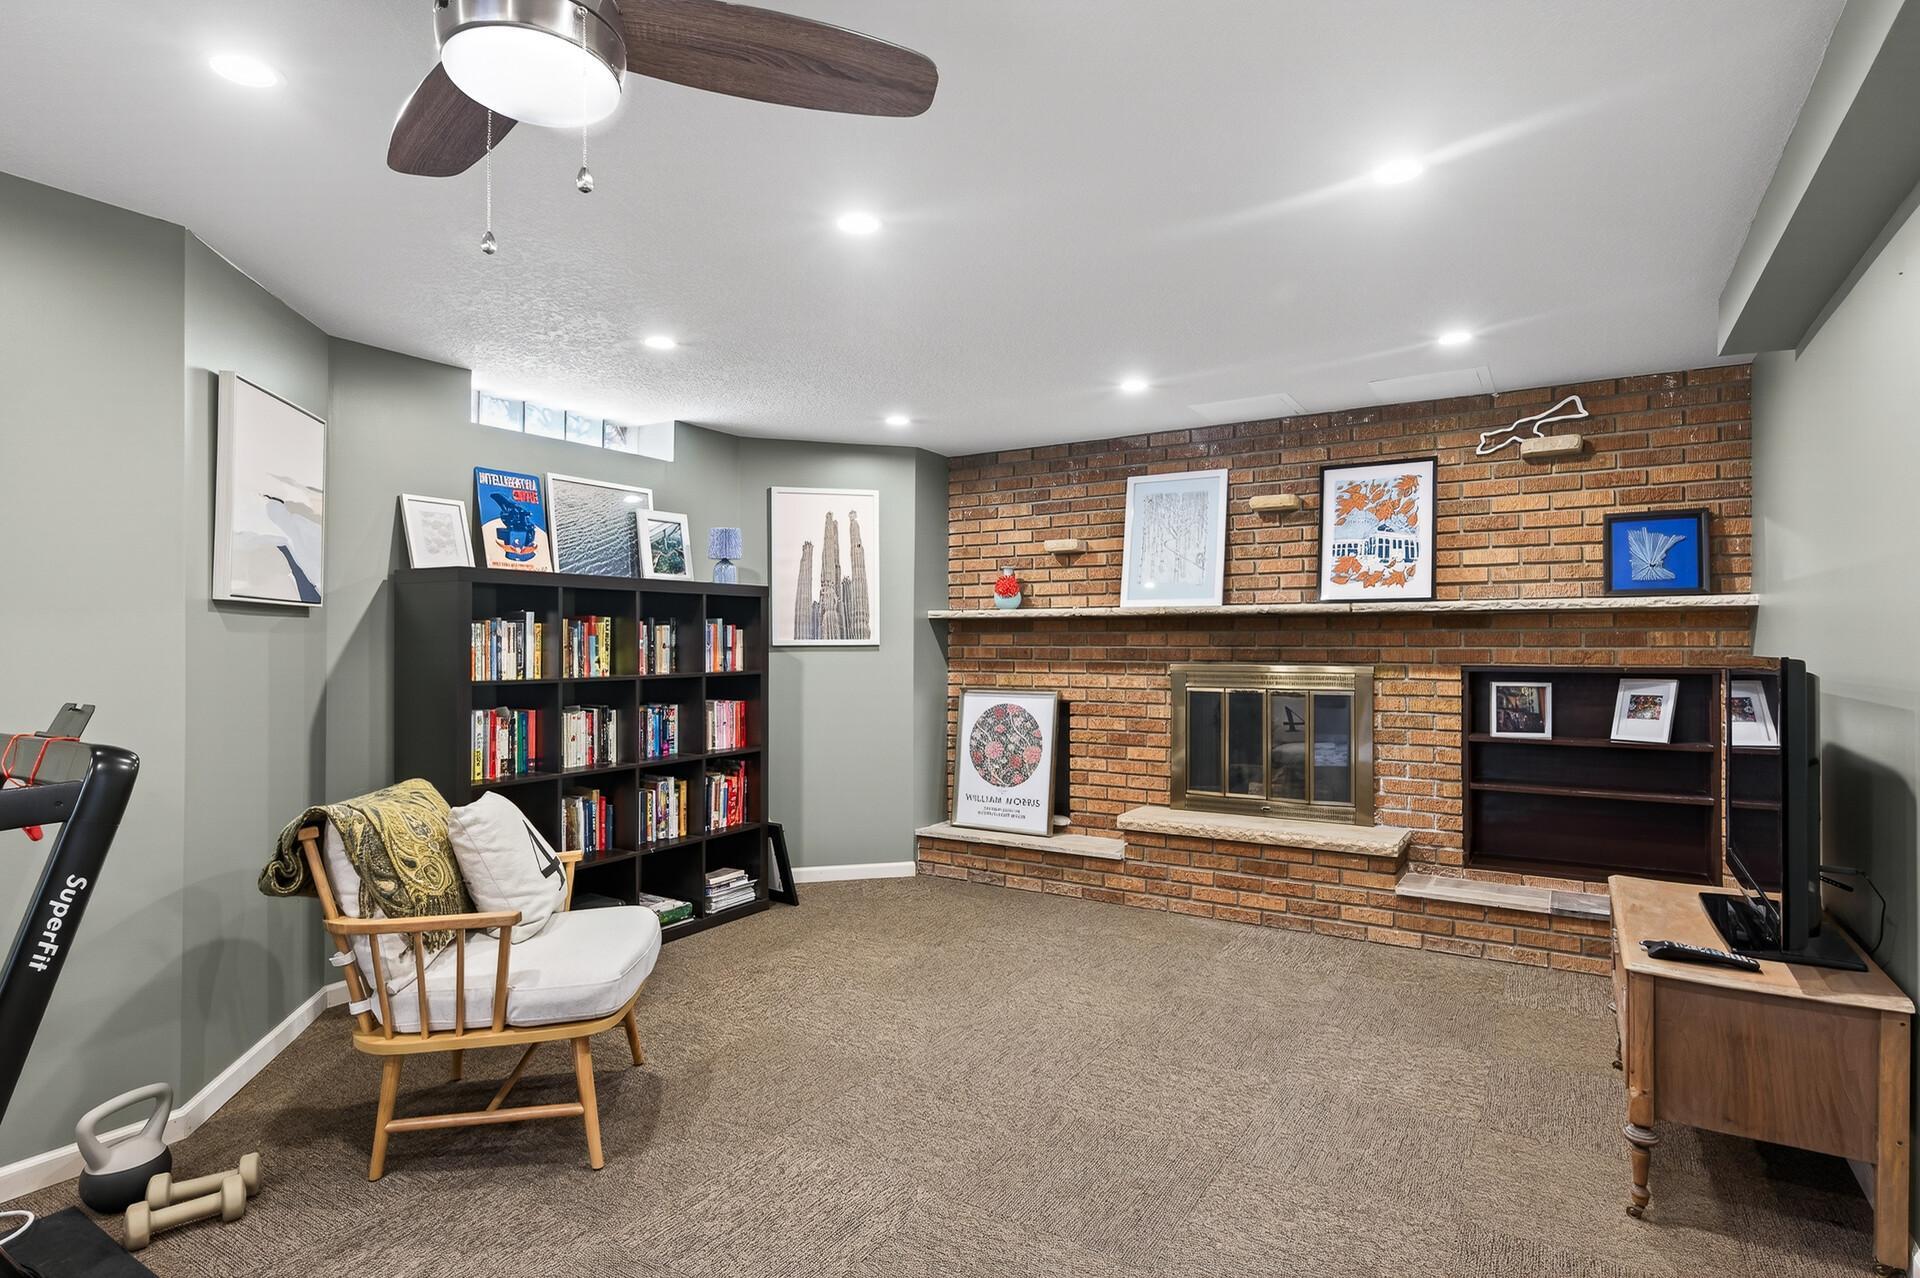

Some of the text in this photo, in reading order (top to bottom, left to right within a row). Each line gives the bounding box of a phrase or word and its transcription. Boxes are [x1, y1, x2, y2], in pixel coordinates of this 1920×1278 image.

[965, 793, 1002, 803] WILLIAM
[522, 819, 566, 892] 4
[28, 874, 88, 973] SuperFit
